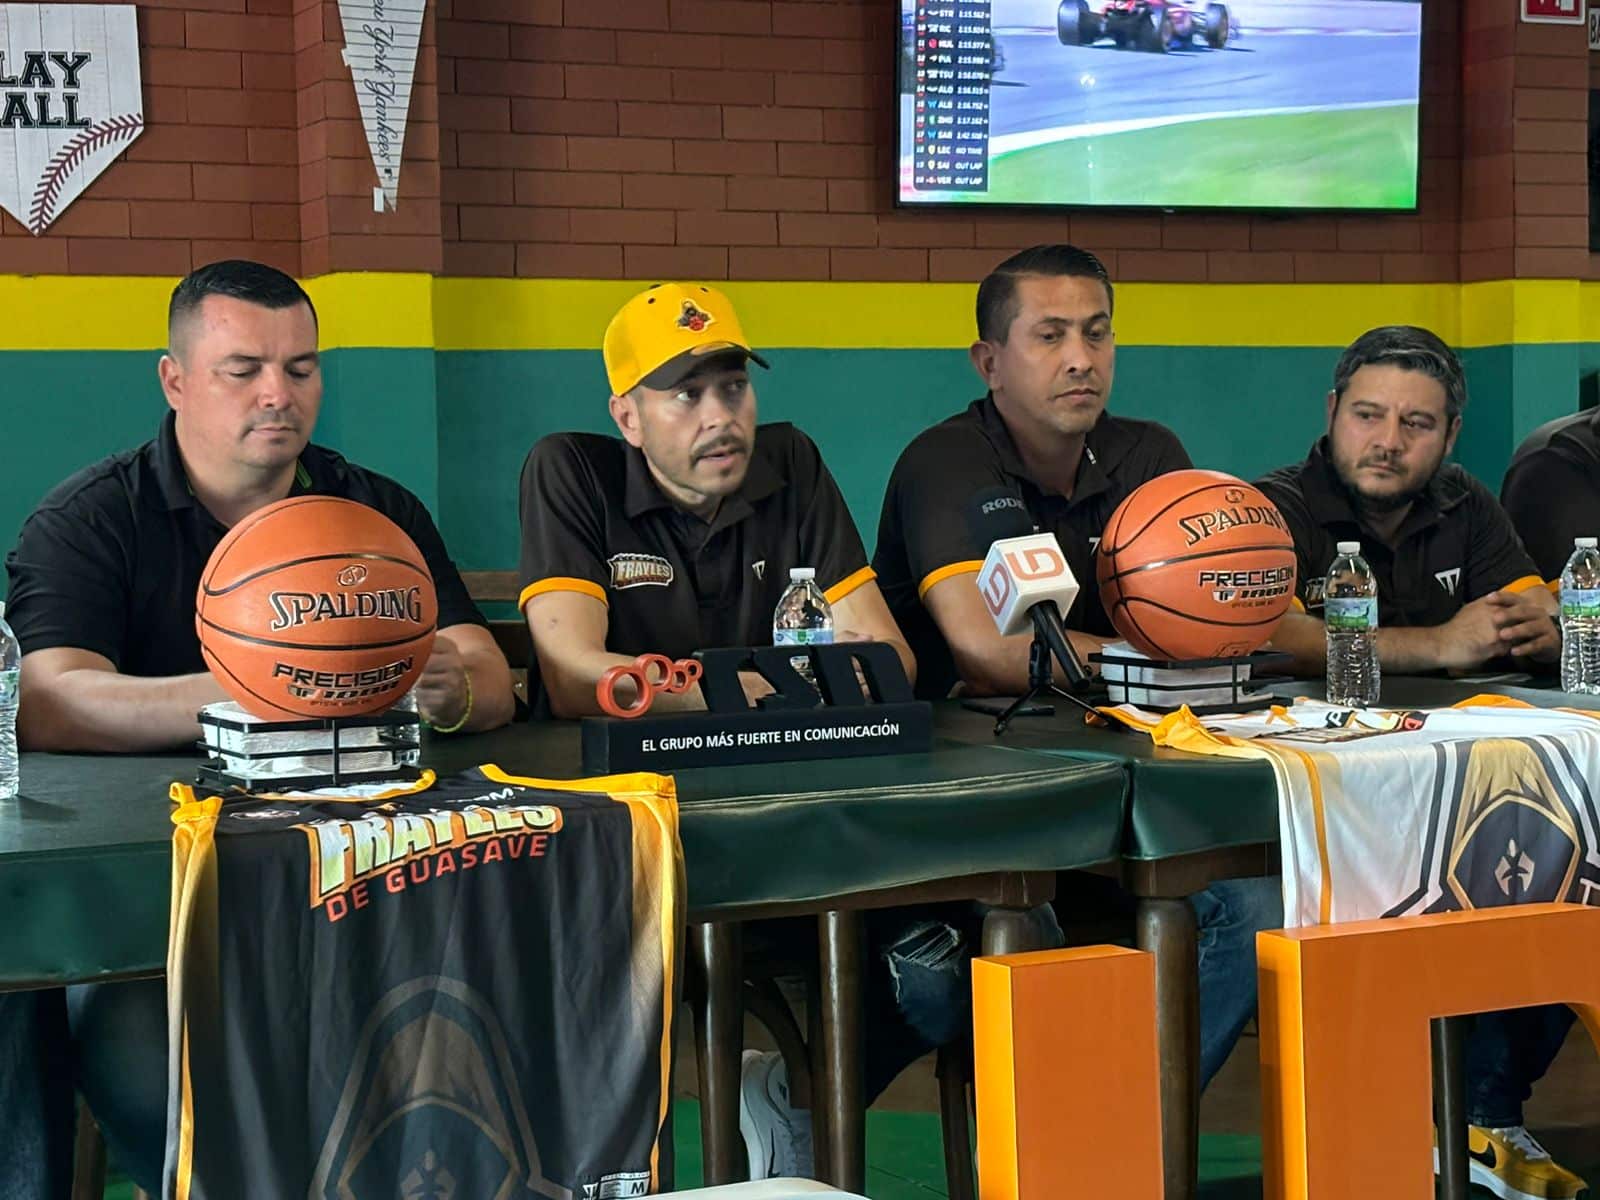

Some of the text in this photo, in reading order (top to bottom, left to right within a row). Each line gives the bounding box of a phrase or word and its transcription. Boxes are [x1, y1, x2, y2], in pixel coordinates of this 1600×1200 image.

[364, 79, 398, 162] Yankees
[614, 561, 670, 583] FRAYLES
[1199, 567, 1294, 588] PRECISION
[269, 586, 422, 632] SPALDING
[272, 657, 413, 689] PRECISION
[641, 718, 900, 752] EL GRUPO MÁS FUERTE EN COMUNICACIÓN
[325, 834, 548, 923] DE GUASAVE
[630, 1180, 646, 1196] M
